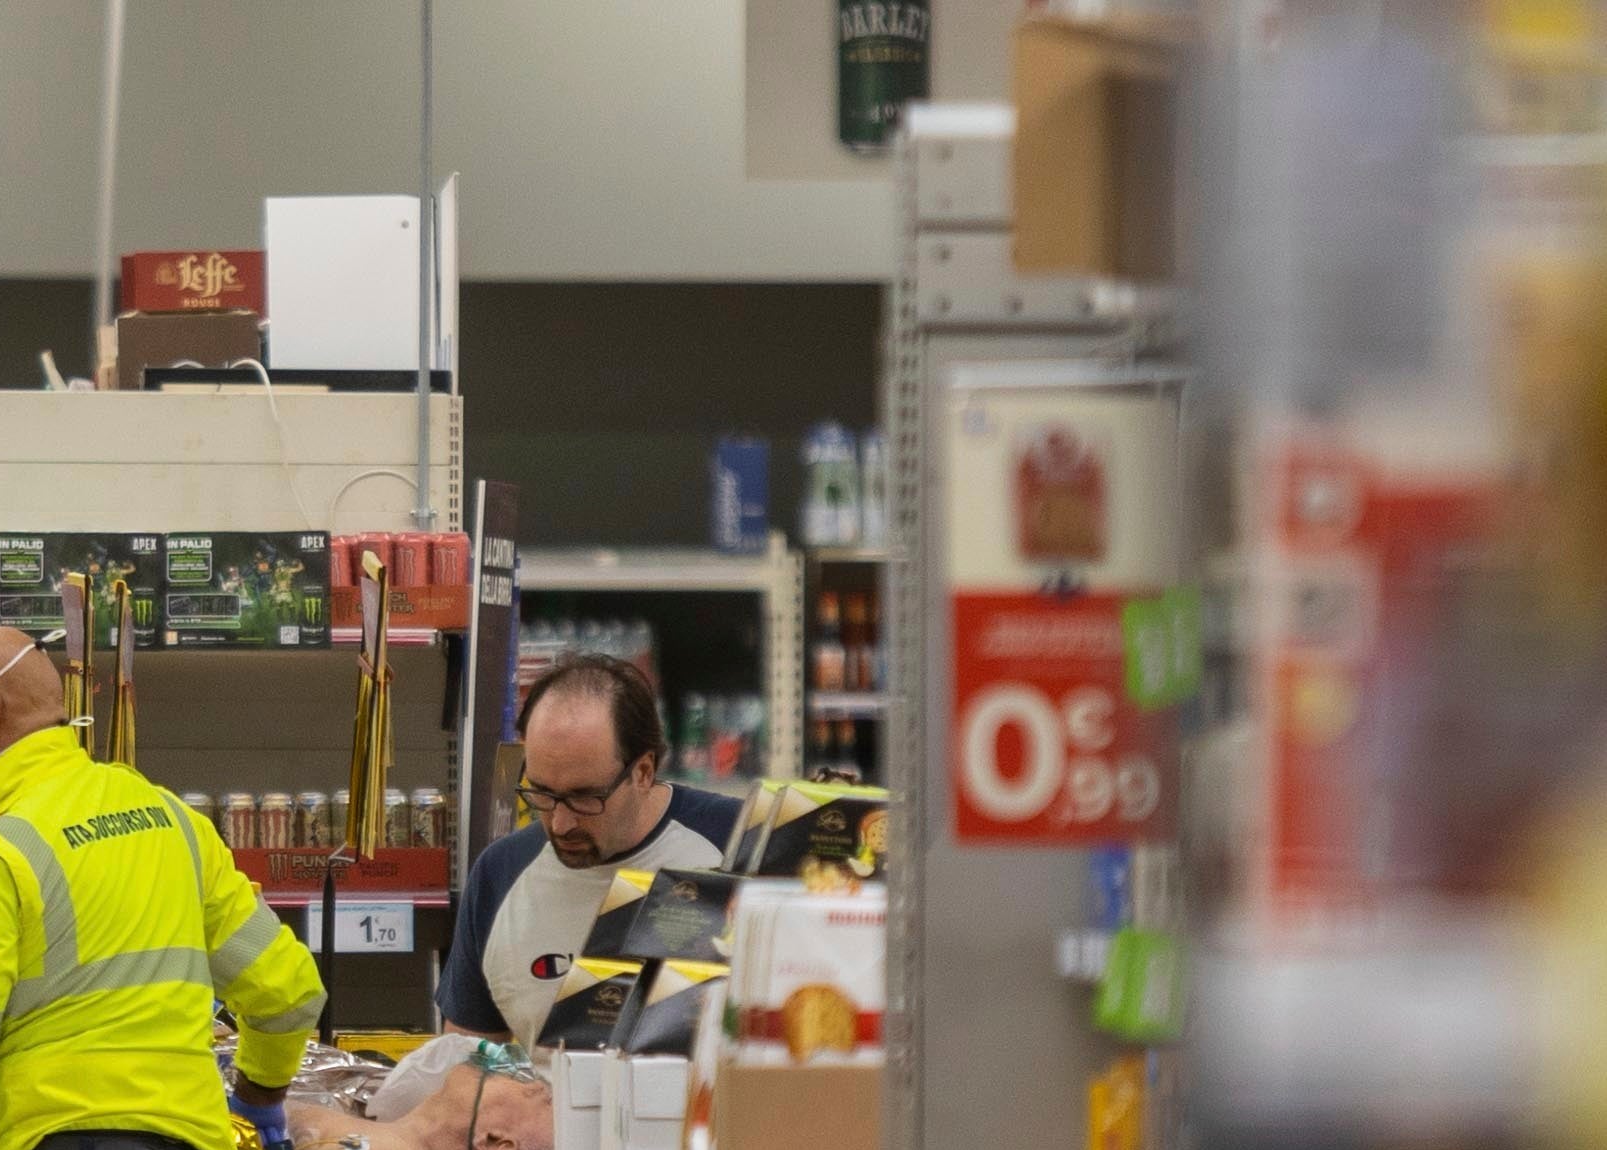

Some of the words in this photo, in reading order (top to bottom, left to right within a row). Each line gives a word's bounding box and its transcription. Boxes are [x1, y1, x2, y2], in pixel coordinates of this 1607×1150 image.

[178, 253, 238, 298] Leffe
[133, 537, 157, 550] APEX
[167, 538, 178, 549] IN
[301, 536, 325, 548] APEX
